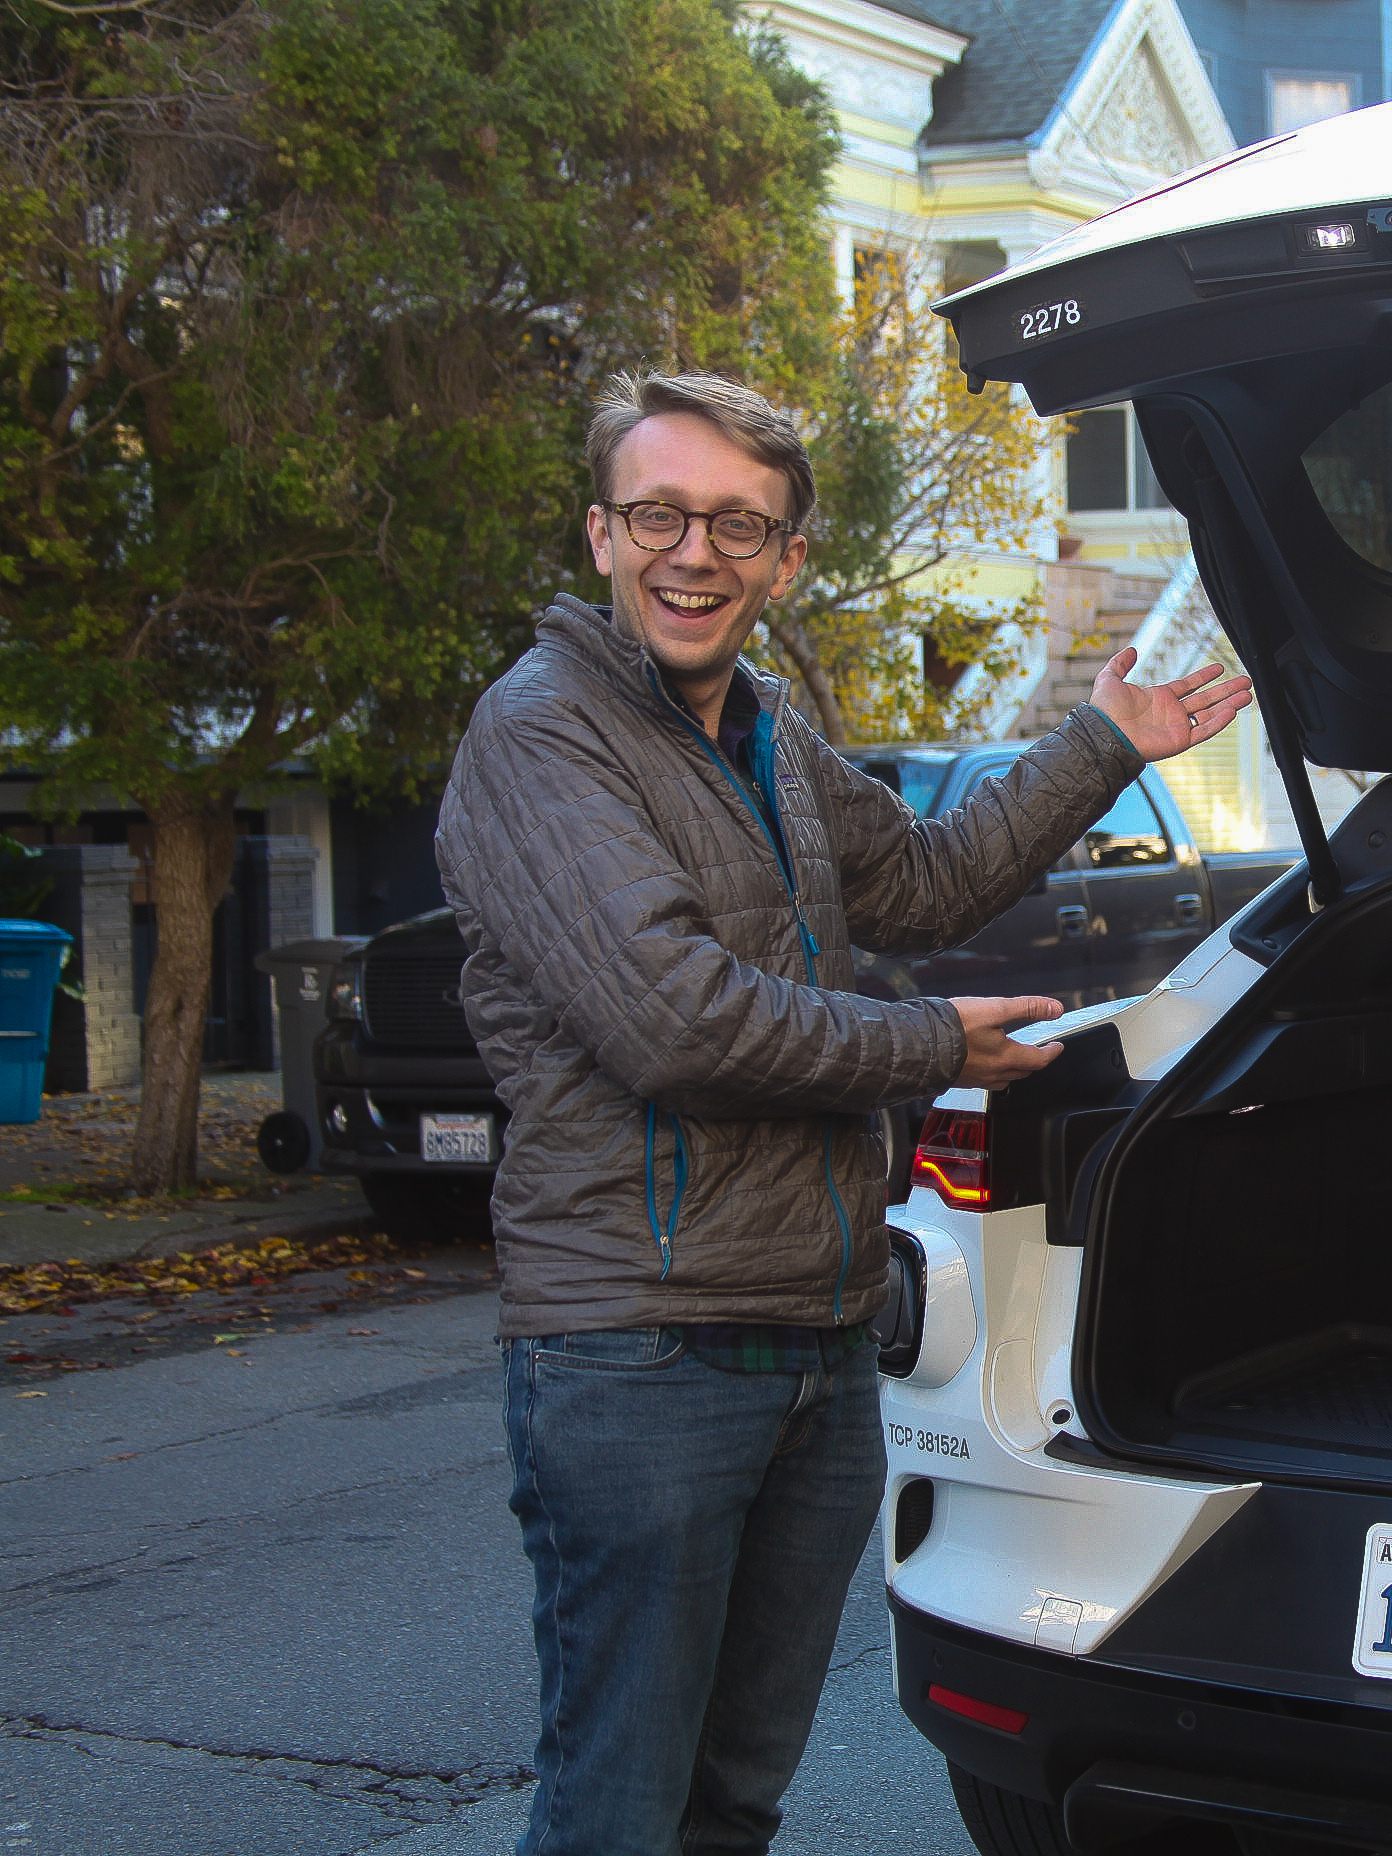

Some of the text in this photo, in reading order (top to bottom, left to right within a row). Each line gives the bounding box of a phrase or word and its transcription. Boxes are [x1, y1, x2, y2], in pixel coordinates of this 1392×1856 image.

[1020, 299, 1081, 339] 2278
[889, 1422, 971, 1460] TCP 38152A
